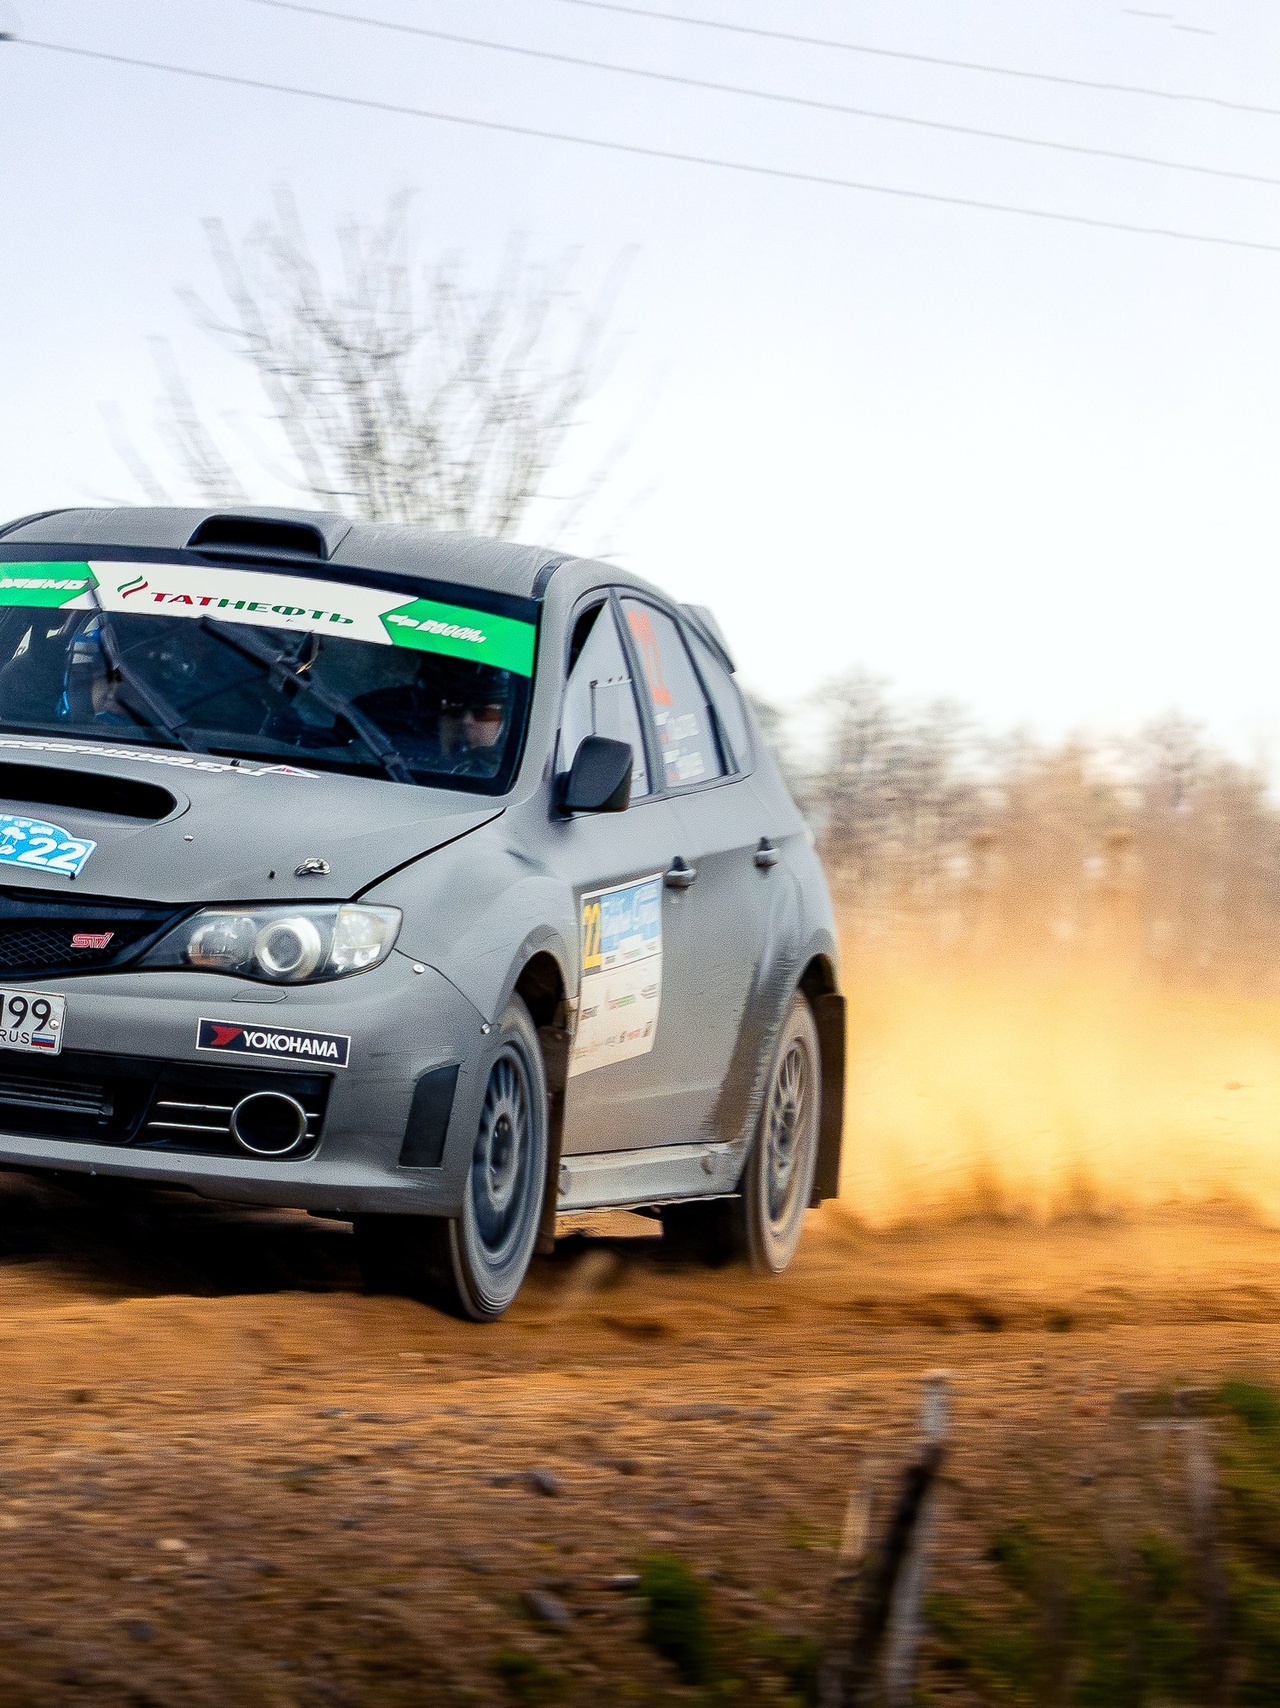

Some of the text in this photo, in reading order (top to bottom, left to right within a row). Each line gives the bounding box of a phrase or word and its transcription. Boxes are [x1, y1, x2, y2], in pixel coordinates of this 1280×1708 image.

[151, 592, 354, 624] ТАТНЕФТЬ
[17, 838, 87, 871] 22
[243, 1030, 339, 1058] YOKOHAMA
